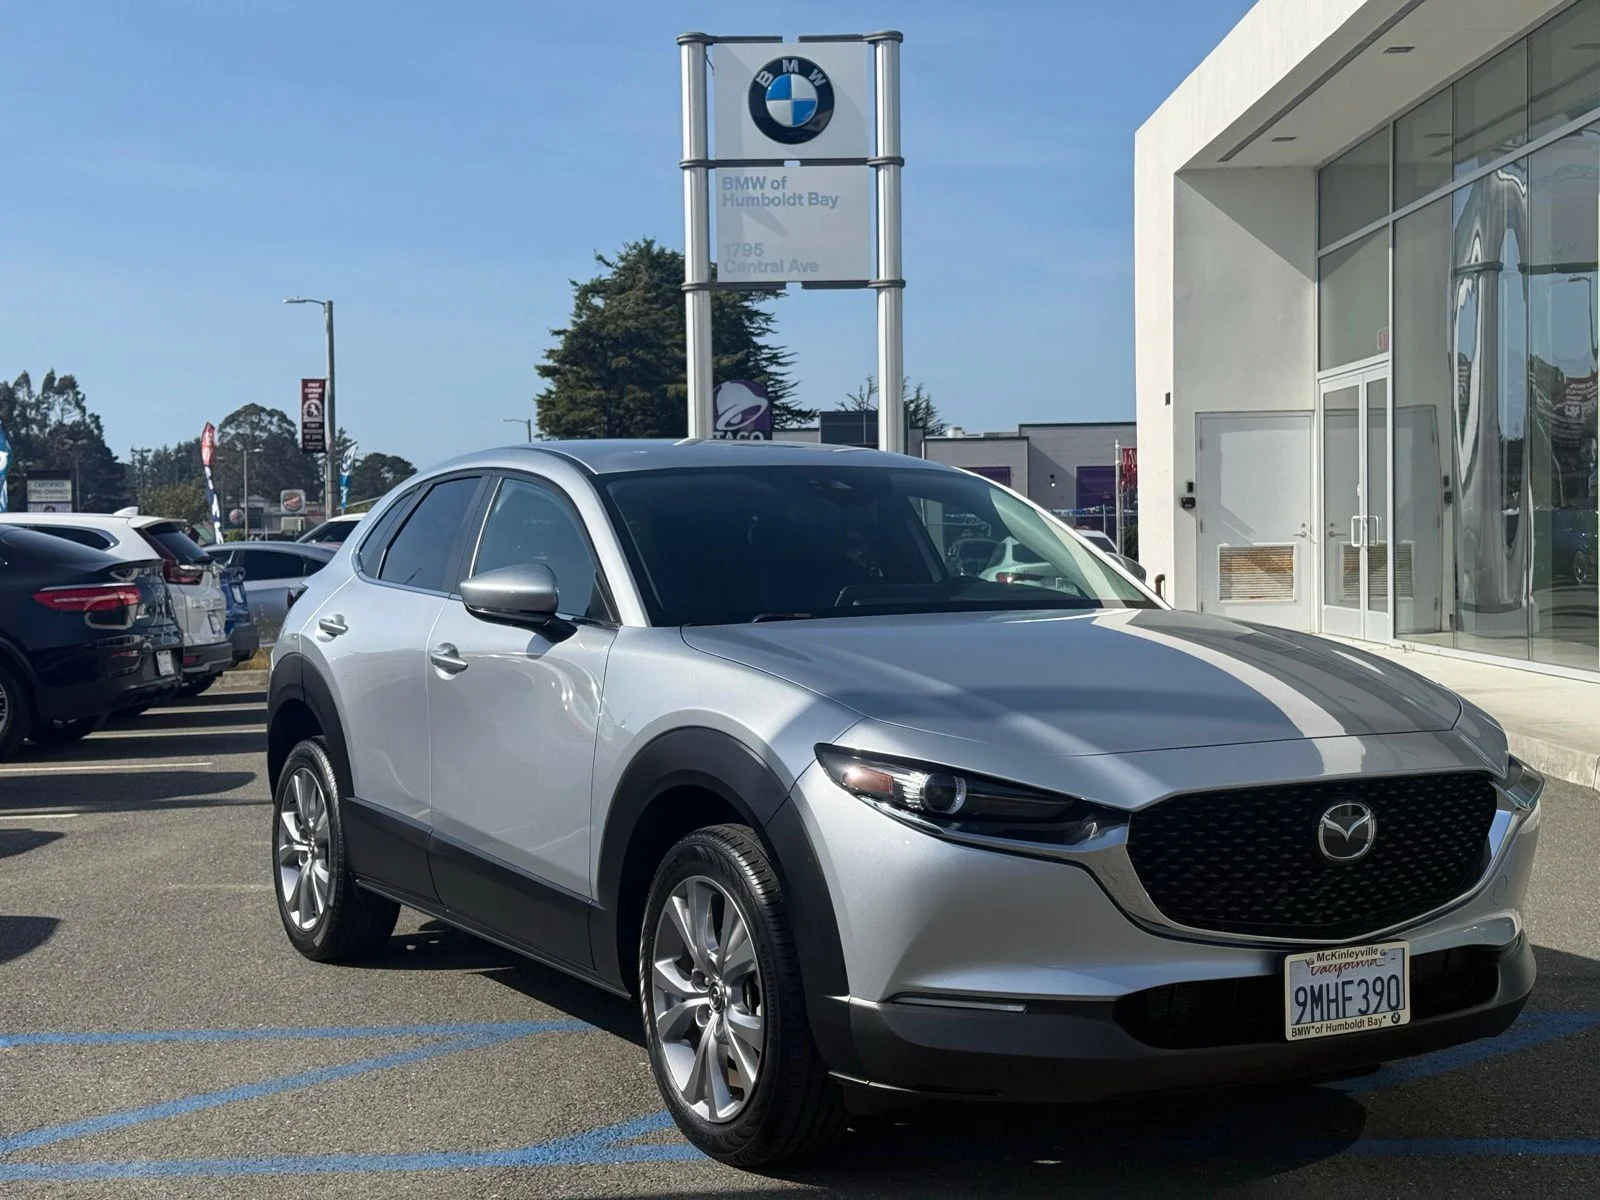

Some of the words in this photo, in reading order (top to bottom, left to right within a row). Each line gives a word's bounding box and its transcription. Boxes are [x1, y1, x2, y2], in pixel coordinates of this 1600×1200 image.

[756, 59, 826, 88] BMW
[722, 176, 766, 191] BMW
[770, 176, 788, 190] of
[722, 192, 804, 208] Humboldt
[807, 192, 839, 209] Bay
[723, 242, 763, 257] 1795
[724, 259, 784, 274] Central
[788, 259, 819, 273] Ave
[713, 431, 764, 440] TACO
[1316, 947, 1379, 963] McKinleyville
[1294, 974, 1400, 1025] 9MHF390
[1315, 1024, 1324, 1035] of
[1325, 1018, 1366, 1033] Humboldt
